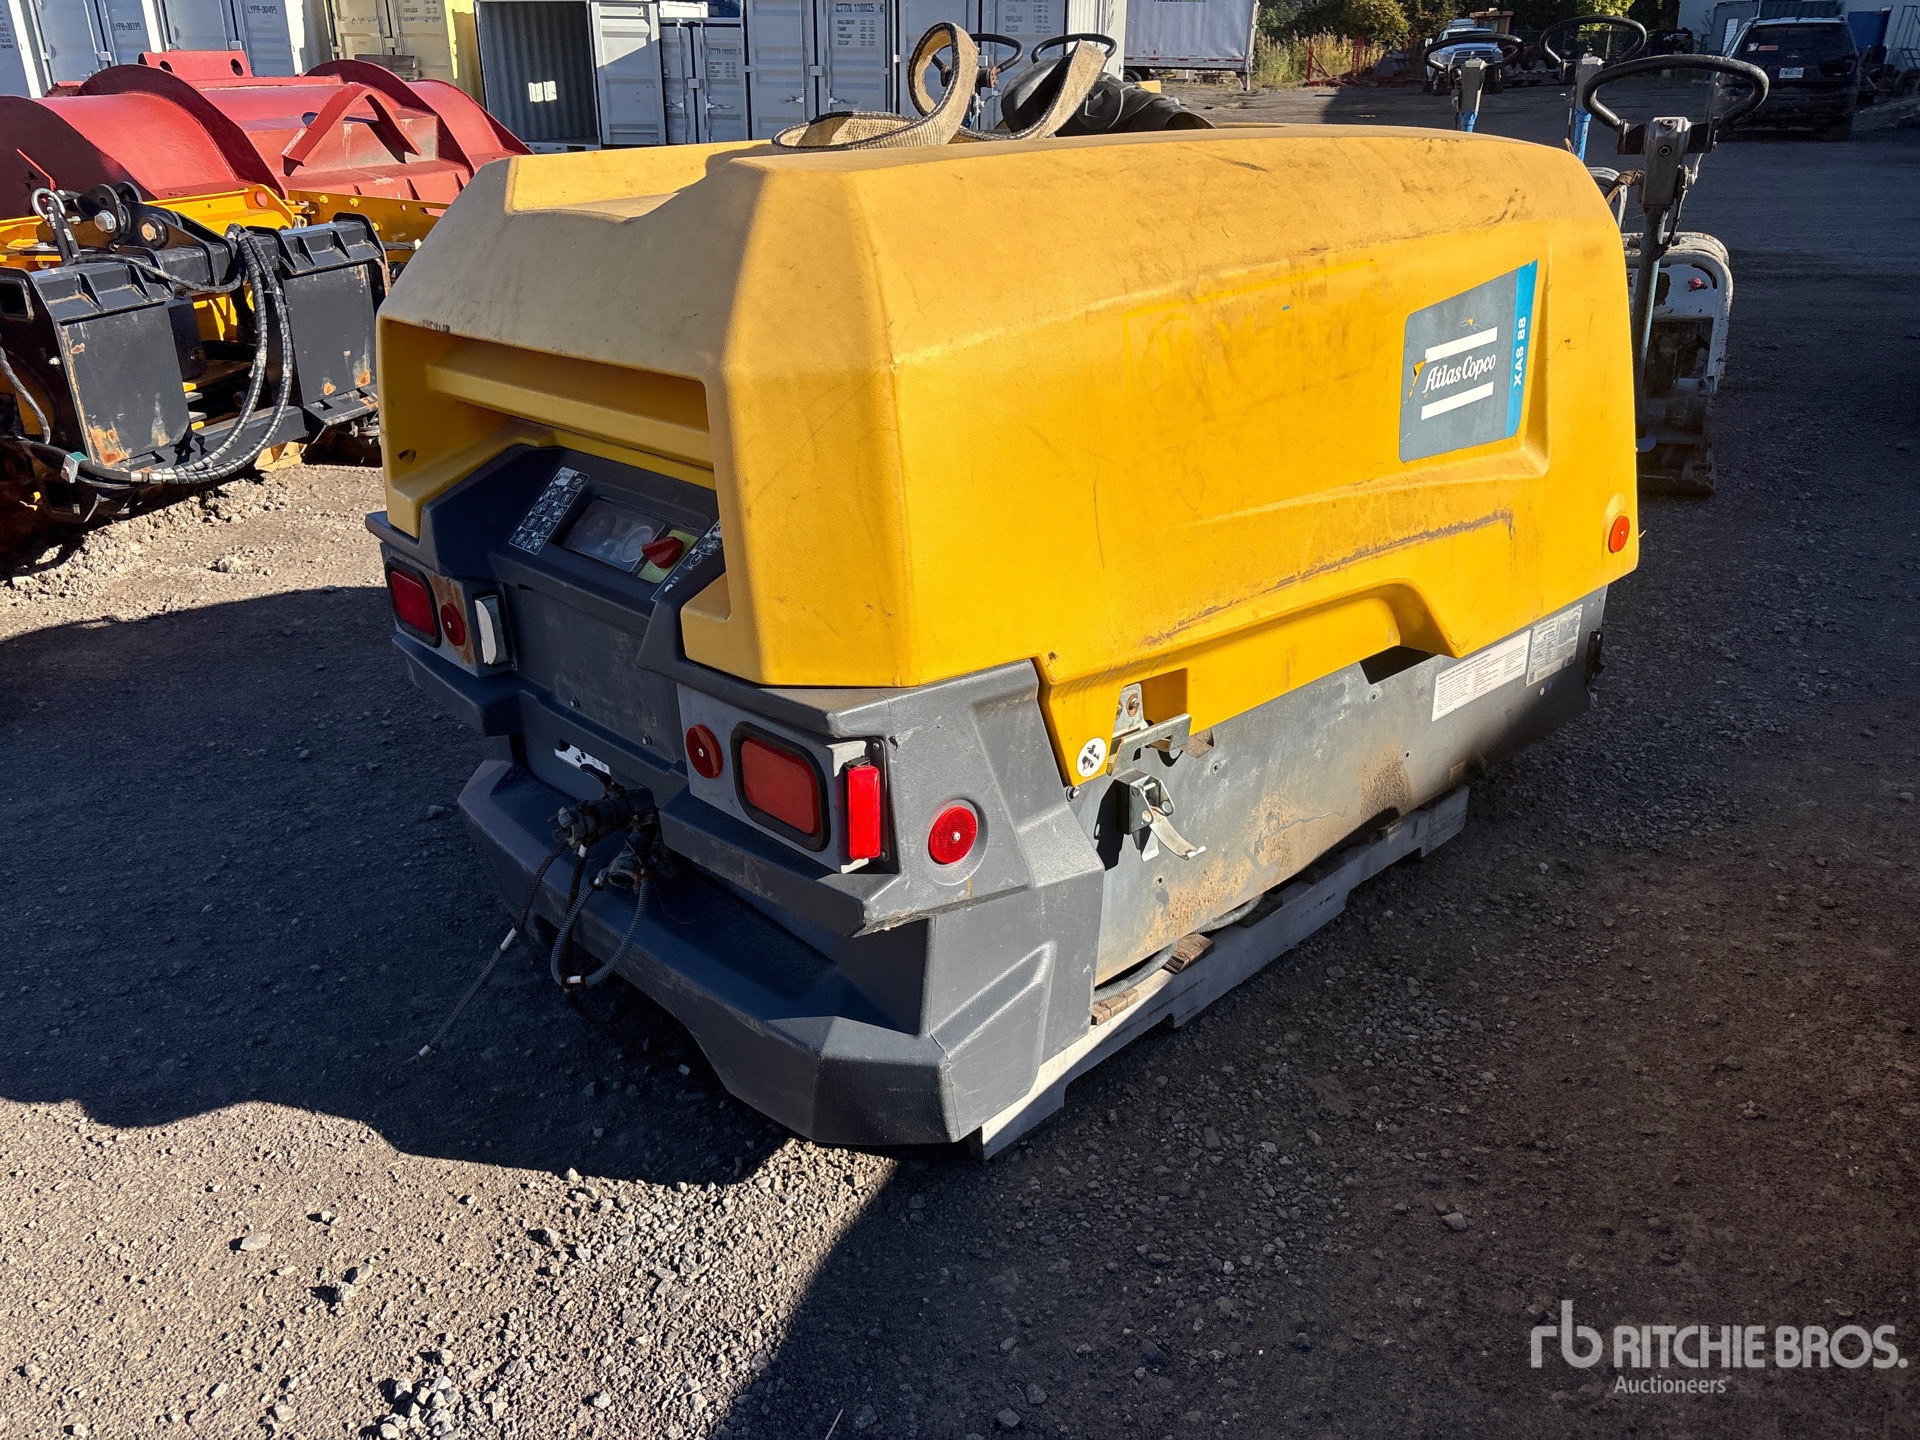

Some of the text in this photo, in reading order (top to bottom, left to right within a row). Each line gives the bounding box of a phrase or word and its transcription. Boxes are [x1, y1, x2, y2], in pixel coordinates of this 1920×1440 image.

[1422, 353, 1496, 393] Atlas Copco
[1514, 316, 1527, 386] XAS 88
